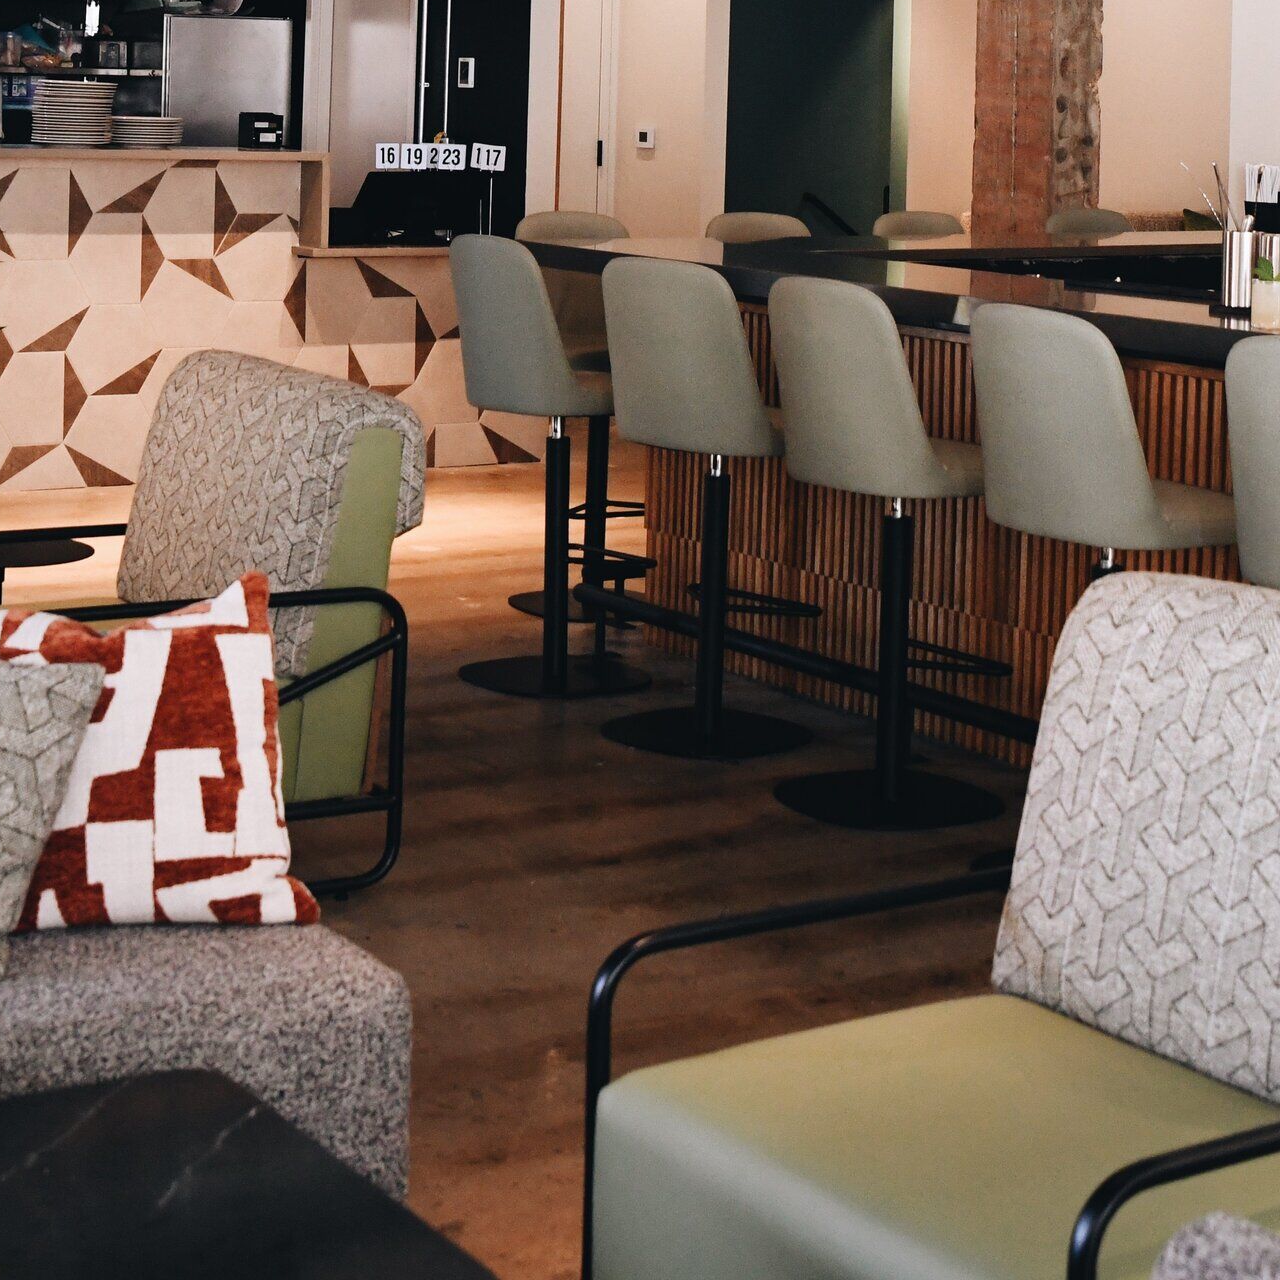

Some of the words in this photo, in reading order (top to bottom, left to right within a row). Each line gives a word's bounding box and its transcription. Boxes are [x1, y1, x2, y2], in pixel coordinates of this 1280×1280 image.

[380, 147, 395, 164] 16
[406, 148, 422, 165] 19
[442, 148, 461, 166] 23
[485, 149, 501, 166] 17
